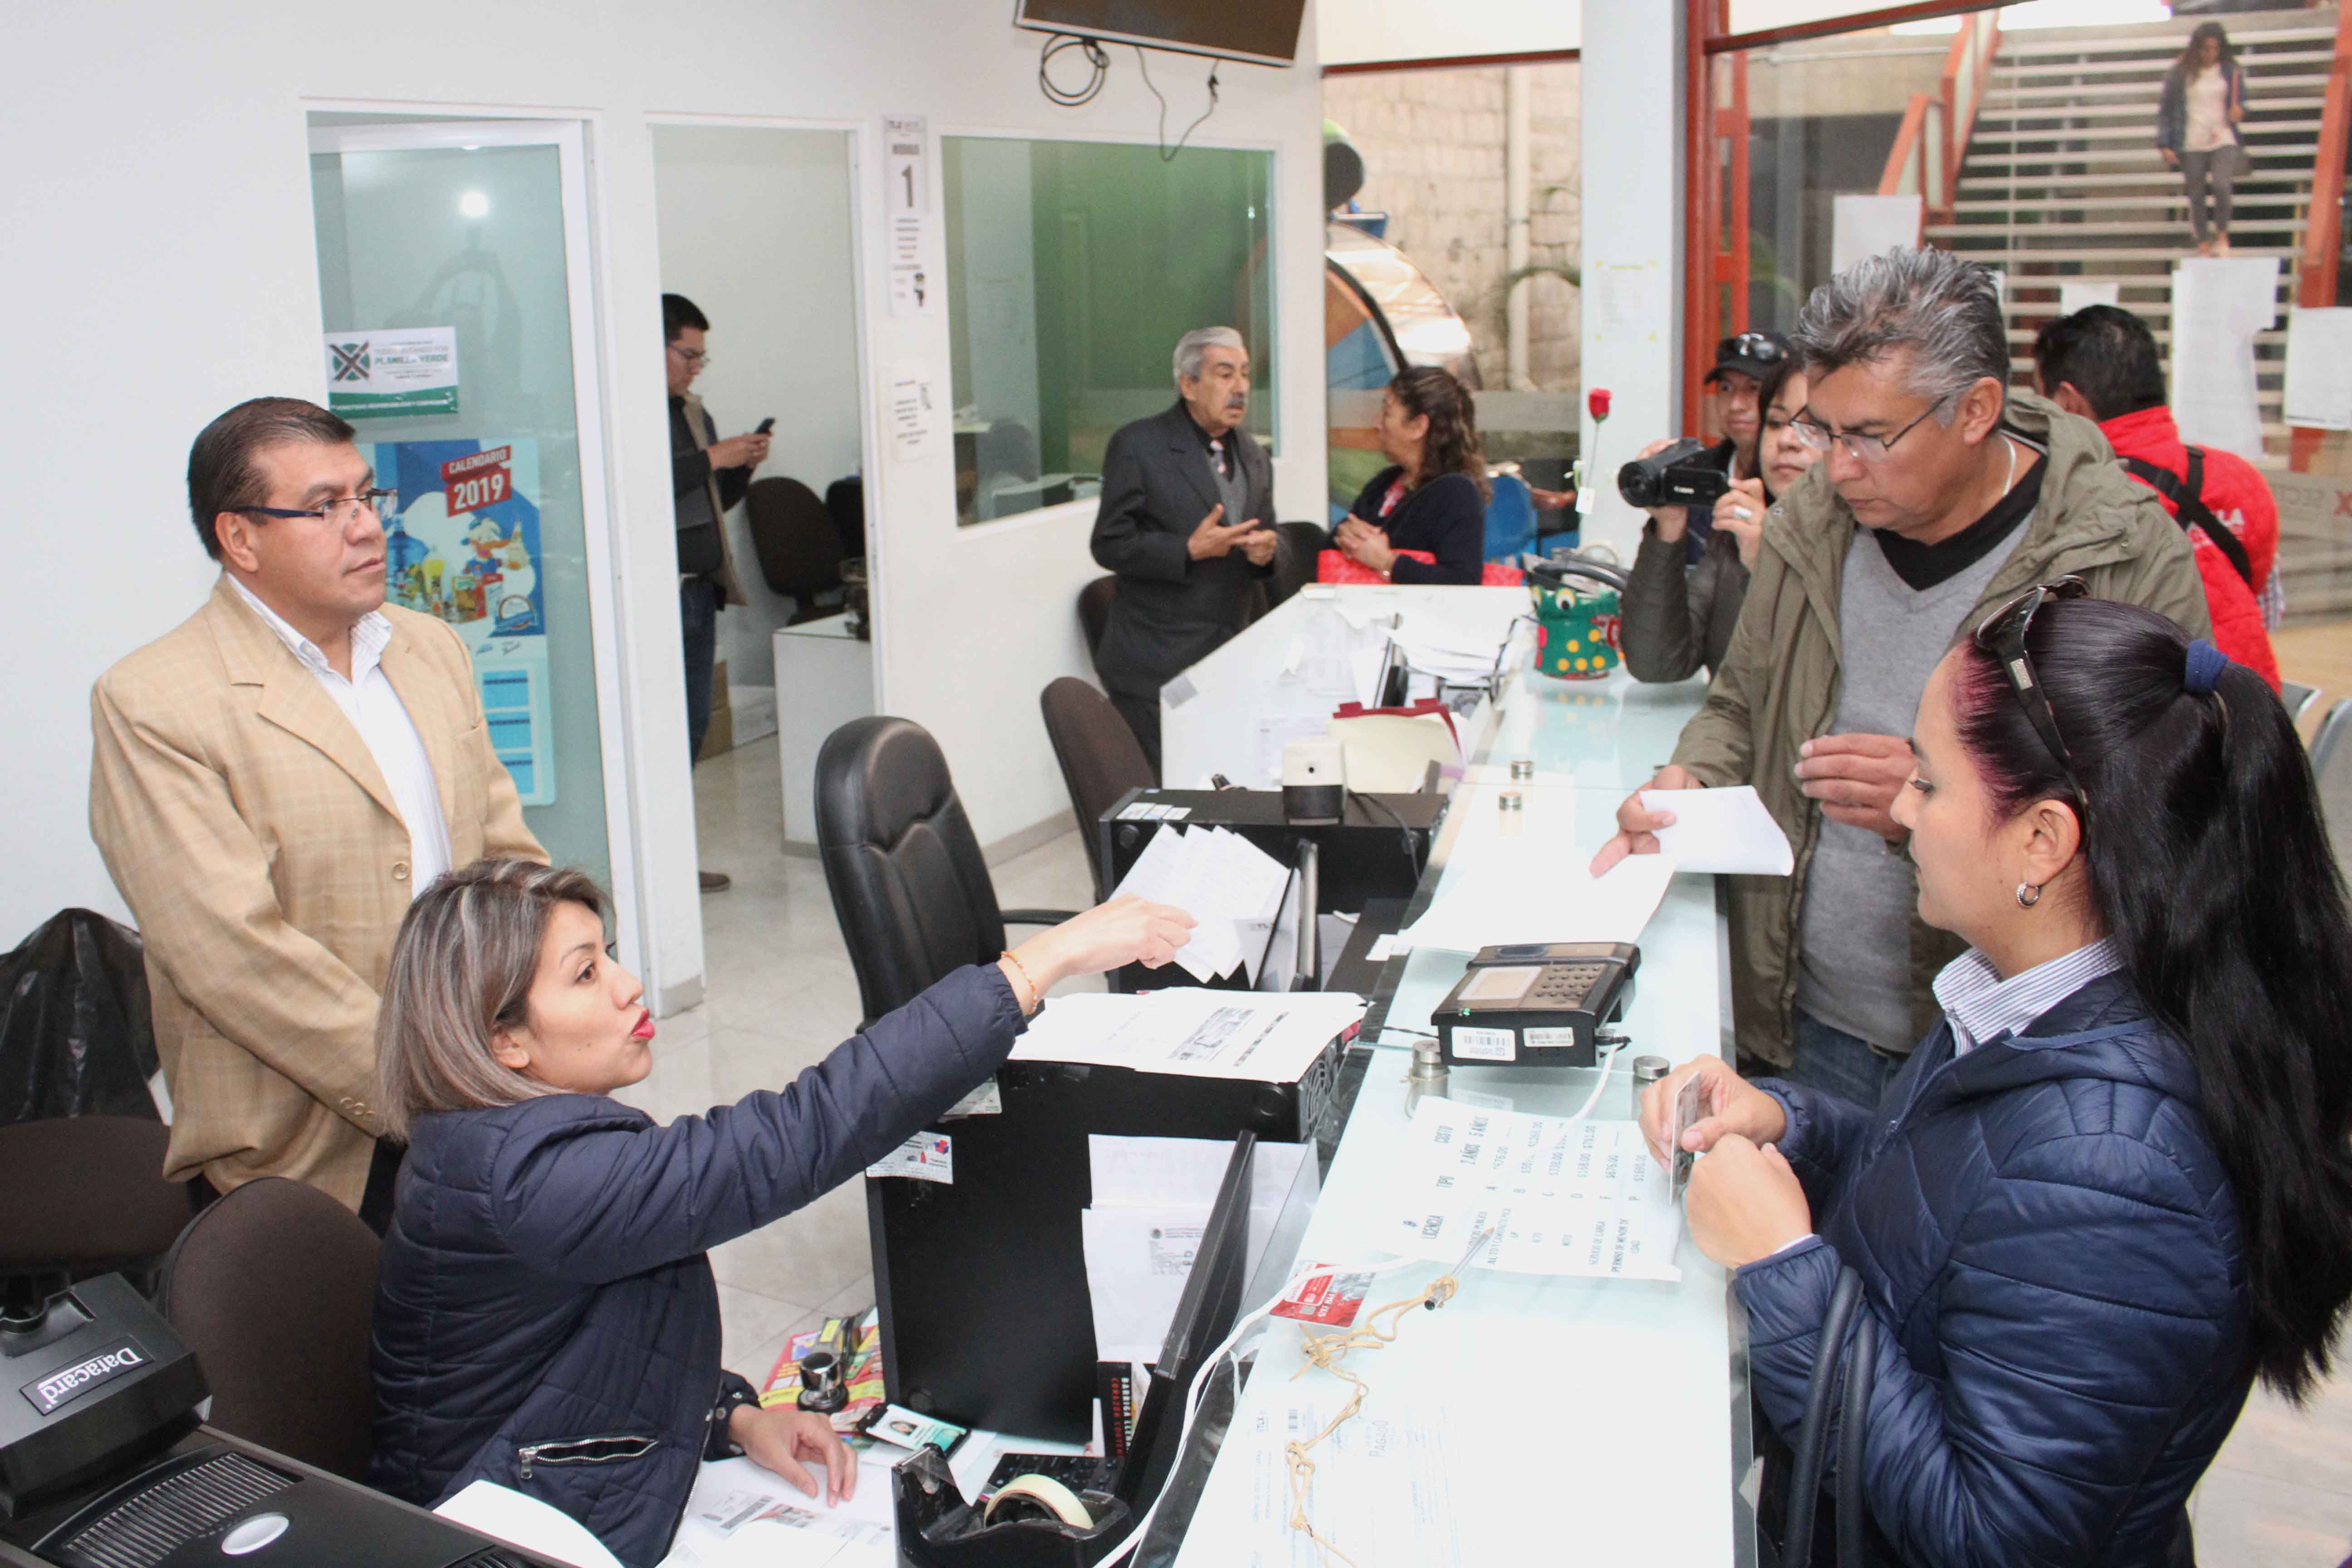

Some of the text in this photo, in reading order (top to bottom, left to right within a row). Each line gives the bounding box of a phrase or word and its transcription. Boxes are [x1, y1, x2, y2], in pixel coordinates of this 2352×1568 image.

[449, 448, 507, 475] CALENDARIO
[454, 474, 504, 510] 2019
[1434, 1125, 1453, 1143] COSTO
[1436, 1175, 1455, 1188] TIPO
[1421, 1215, 1444, 1239] LICENCIA
[38, 1348, 143, 1405] Datacard
[1121, 1377, 1132, 1417] BARRIGA
